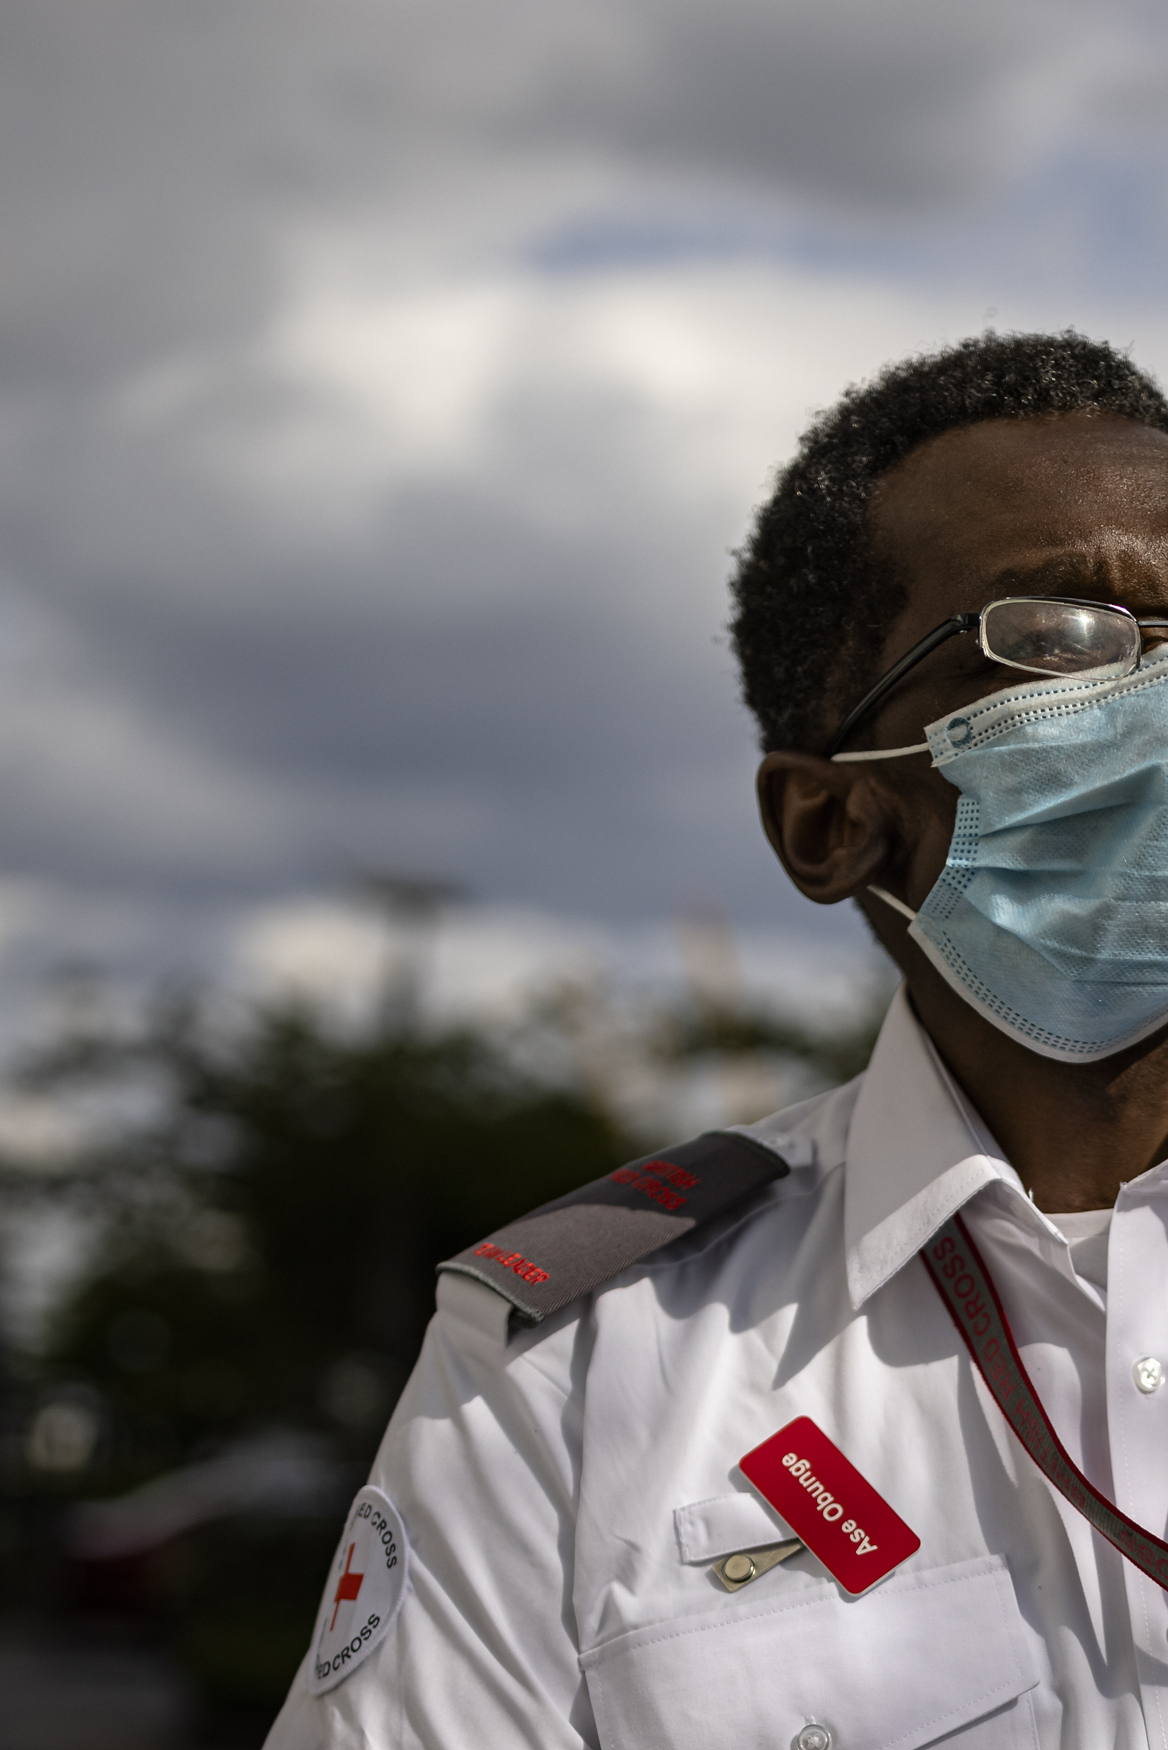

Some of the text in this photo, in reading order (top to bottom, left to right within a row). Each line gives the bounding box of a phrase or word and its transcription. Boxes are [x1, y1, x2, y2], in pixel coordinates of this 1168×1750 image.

[632, 1176, 687, 1210] CROSS
[932, 1236, 991, 1337] CROSS
[983, 1336, 1017, 1401] RED
[781, 1452, 878, 1556] Ase Obunge
[370, 1511, 397, 1569] CROSS
[332, 1613, 381, 1671] CROSS
